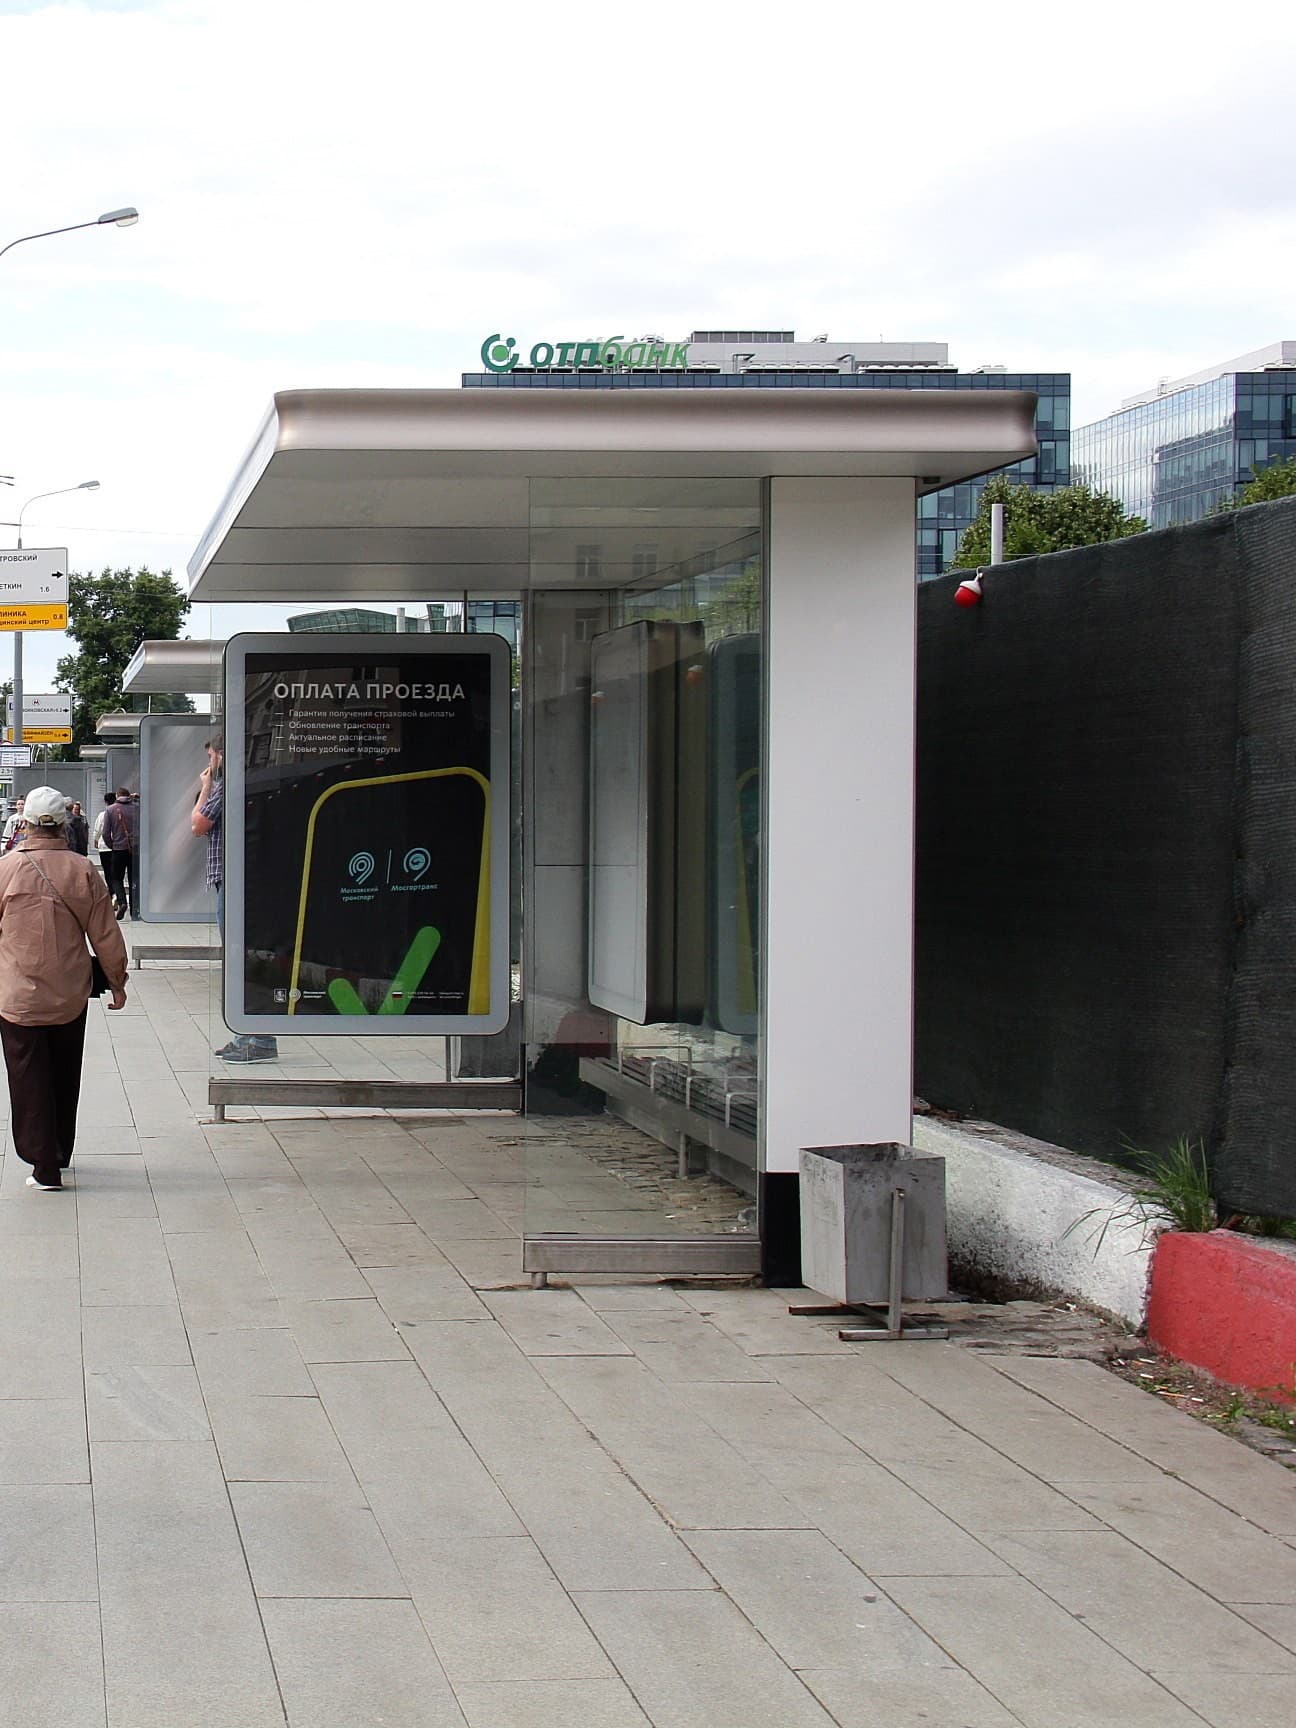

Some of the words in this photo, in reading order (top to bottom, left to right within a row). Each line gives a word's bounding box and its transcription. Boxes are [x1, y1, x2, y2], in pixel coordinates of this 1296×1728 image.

[28, 618, 50, 626] центр
[274, 683, 361, 699] ОПЛАТА
[367, 683, 466, 701] ПРОЕЗДА
[288, 709, 327, 719] Гарантия
[329, 710, 373, 719] получения
[374, 709, 417, 719] страховой
[419, 710, 455, 718] выплаты
[288, 721, 341, 730] Обновление
[343, 722, 390, 731] транспорта
[288, 733, 337, 743] Актуальное
[339, 734, 388, 743] расписание
[288, 745, 317, 754] Новые
[318, 745, 355, 755] удобные
[356, 745, 401, 755] маршруты
